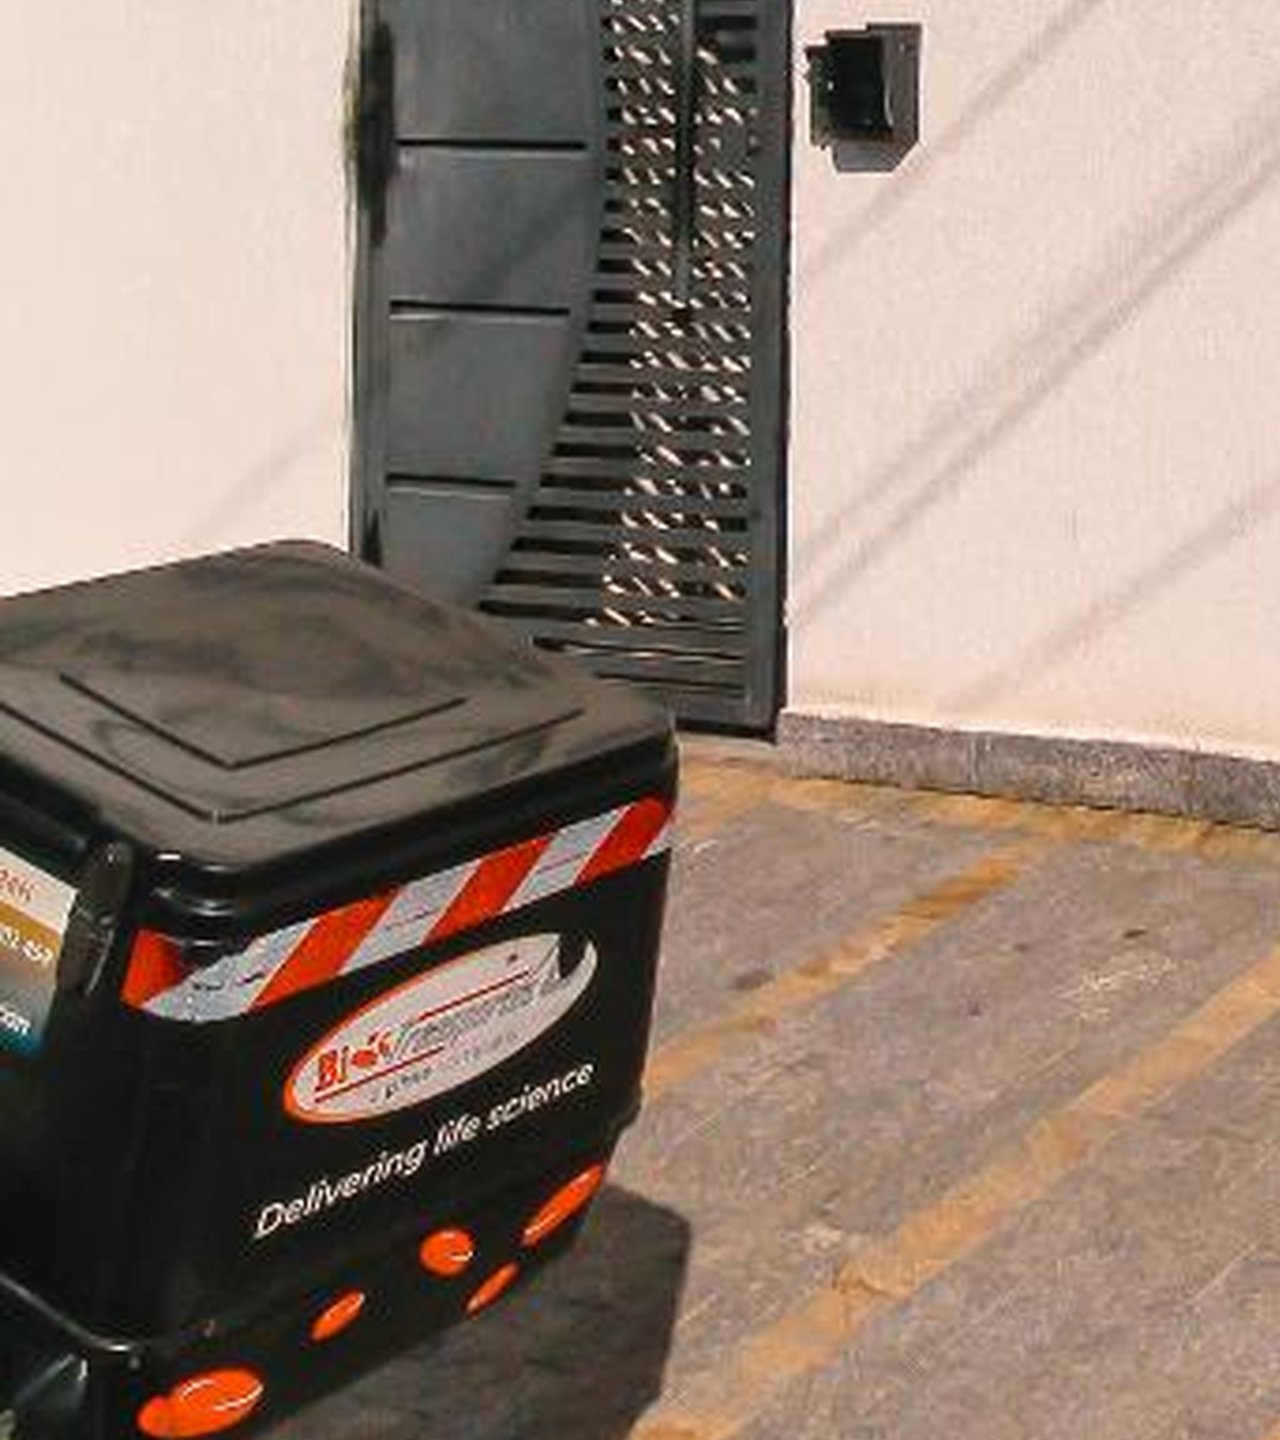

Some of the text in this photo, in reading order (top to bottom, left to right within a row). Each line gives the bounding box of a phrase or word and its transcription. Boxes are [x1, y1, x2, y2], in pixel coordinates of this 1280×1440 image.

[253, 1138, 429, 1238] Delivering
[433, 1113, 481, 1156] life
[485, 1063, 595, 1131] science
